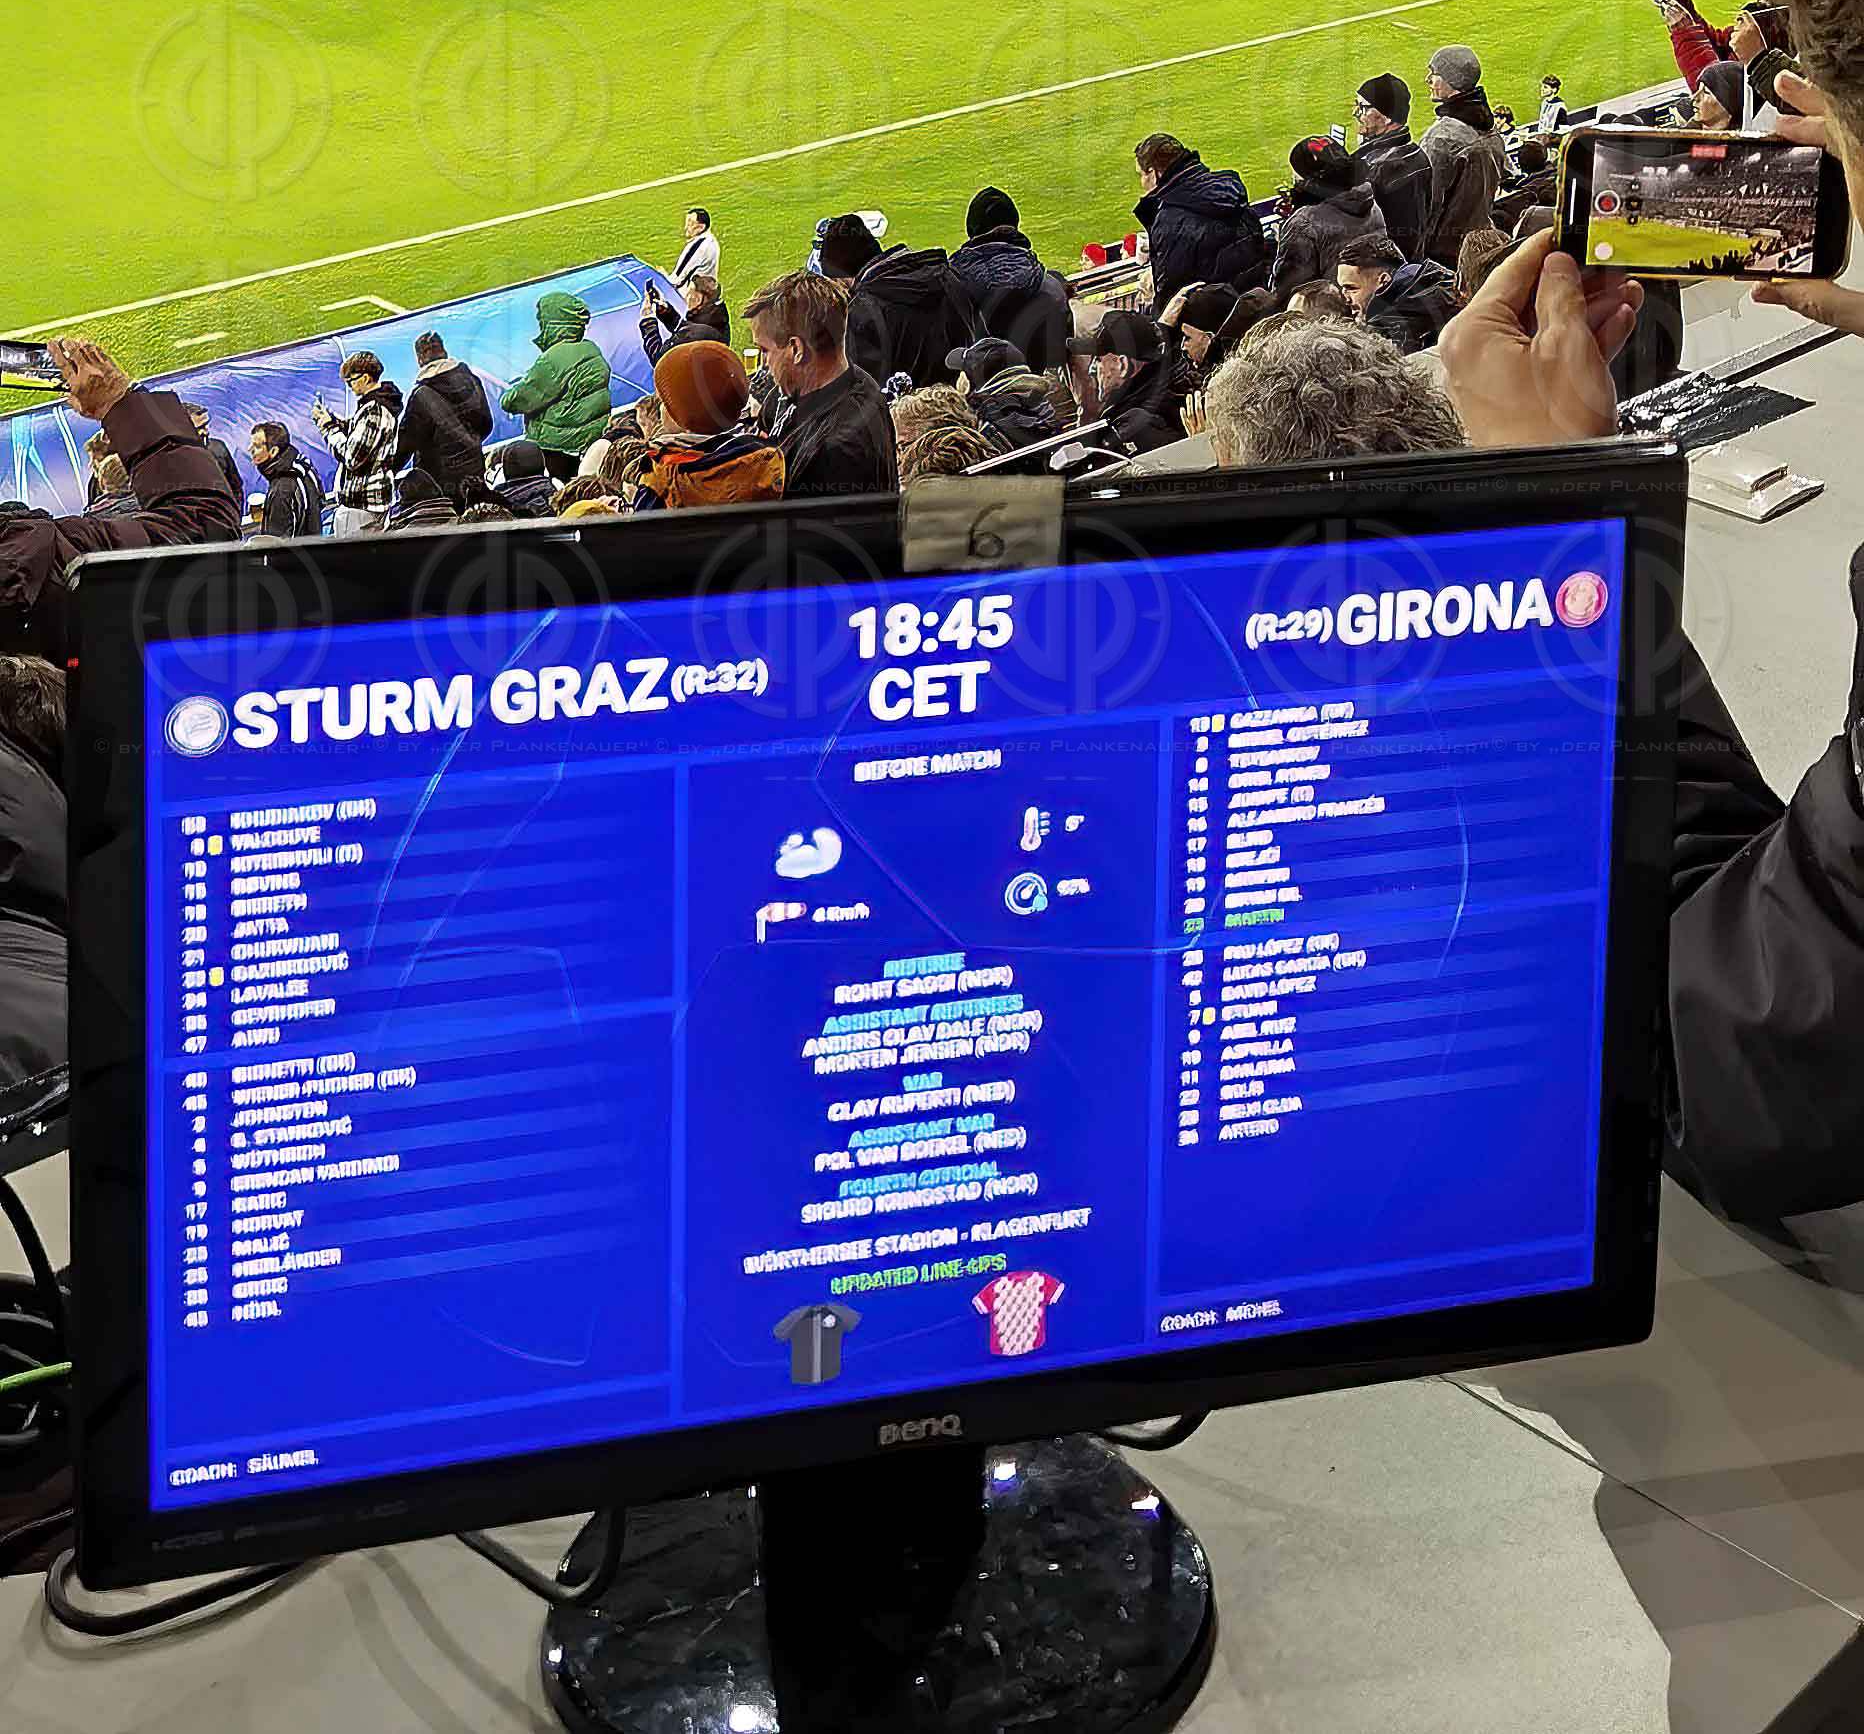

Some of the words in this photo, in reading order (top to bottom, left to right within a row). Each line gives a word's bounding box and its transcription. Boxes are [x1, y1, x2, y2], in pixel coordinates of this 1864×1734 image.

[967, 502, 1008, 558] 6
[849, 595, 1013, 658] 18:45
[1245, 612, 1333, 649] (R:29)
[1335, 579, 1553, 645] GIRONA
[231, 675, 473, 749] STURM
[490, 656, 670, 725] GRAZ
[671, 659, 769, 702] (R:32)
[869, 661, 992, 721] CET
[874, 1228, 958, 1259] STADION
[970, 1207, 1093, 1242] KLAGENFURT
